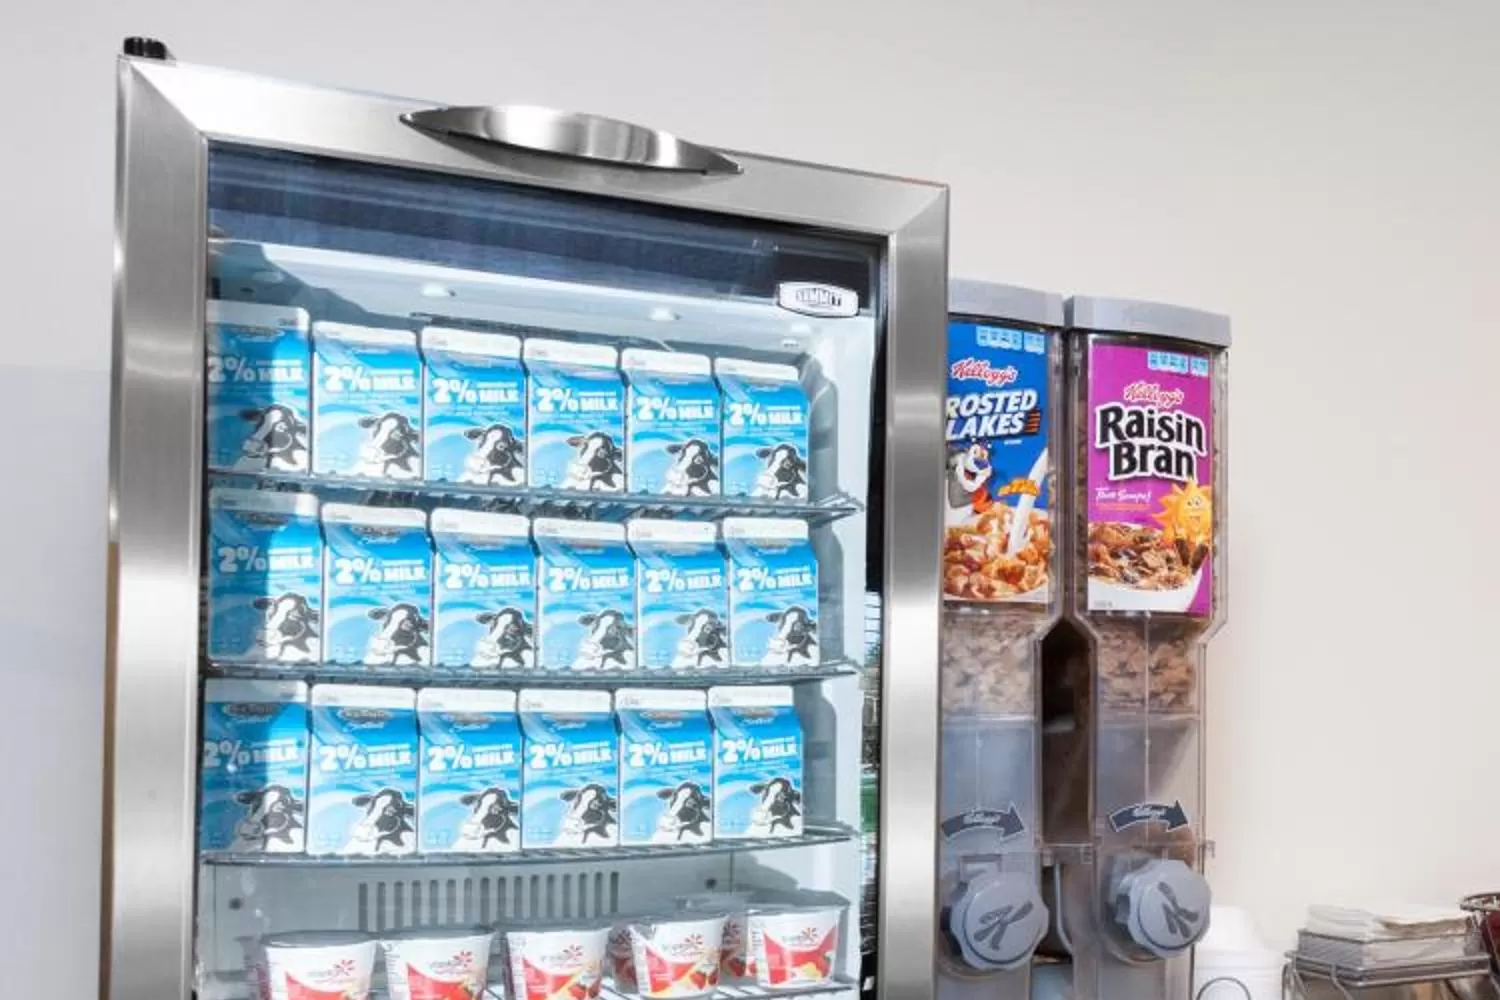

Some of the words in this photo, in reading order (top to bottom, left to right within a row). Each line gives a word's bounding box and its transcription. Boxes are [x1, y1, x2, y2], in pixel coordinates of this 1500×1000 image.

[207, 355, 256, 383] 2%
[322, 364, 371, 393] 2%
[373, 374, 416, 392] MILK
[951, 358, 1018, 388] Kellogg's
[432, 378, 478, 404] 2%
[479, 387, 519, 404] MILK
[535, 386, 579, 413] 2%
[580, 396, 619, 412] MILK
[945, 388, 1038, 419] ROSTED
[1124, 380, 1184, 409] Kellogg's
[635, 395, 677, 421] 2%
[678, 403, 715, 420] MILK
[728, 402, 768, 427] 2%
[768, 410, 805, 426] MILK
[945, 411, 1026, 441] LAKES
[1098, 404, 1204, 453] Raisin
[1112, 441, 1195, 480] Bran
[217, 546, 265, 573] 2%
[335, 557, 381, 585] 2%
[383, 565, 426, 582] MILK
[444, 562, 488, 590] 2%
[490, 571, 531, 588] MILK
[549, 566, 590, 592] 2%
[592, 572, 629, 589] MILK
[646, 566, 684, 593] 2%
[687, 573, 721, 589] MILK
[737, 564, 776, 591] 2%
[778, 571, 813, 588] MILK
[202, 737, 249, 768] 2%
[319, 744, 366, 772] 2%
[369, 750, 411, 768] MILK
[428, 743, 472, 771] 2%
[475, 749, 515, 767] MILK
[529, 742, 572, 769] 2%
[574, 747, 612, 765] MILK
[628, 742, 668, 768] 2%
[671, 746, 706, 764] MILK
[721, 737, 761, 764] 2%
[763, 740, 798, 760] MILK
